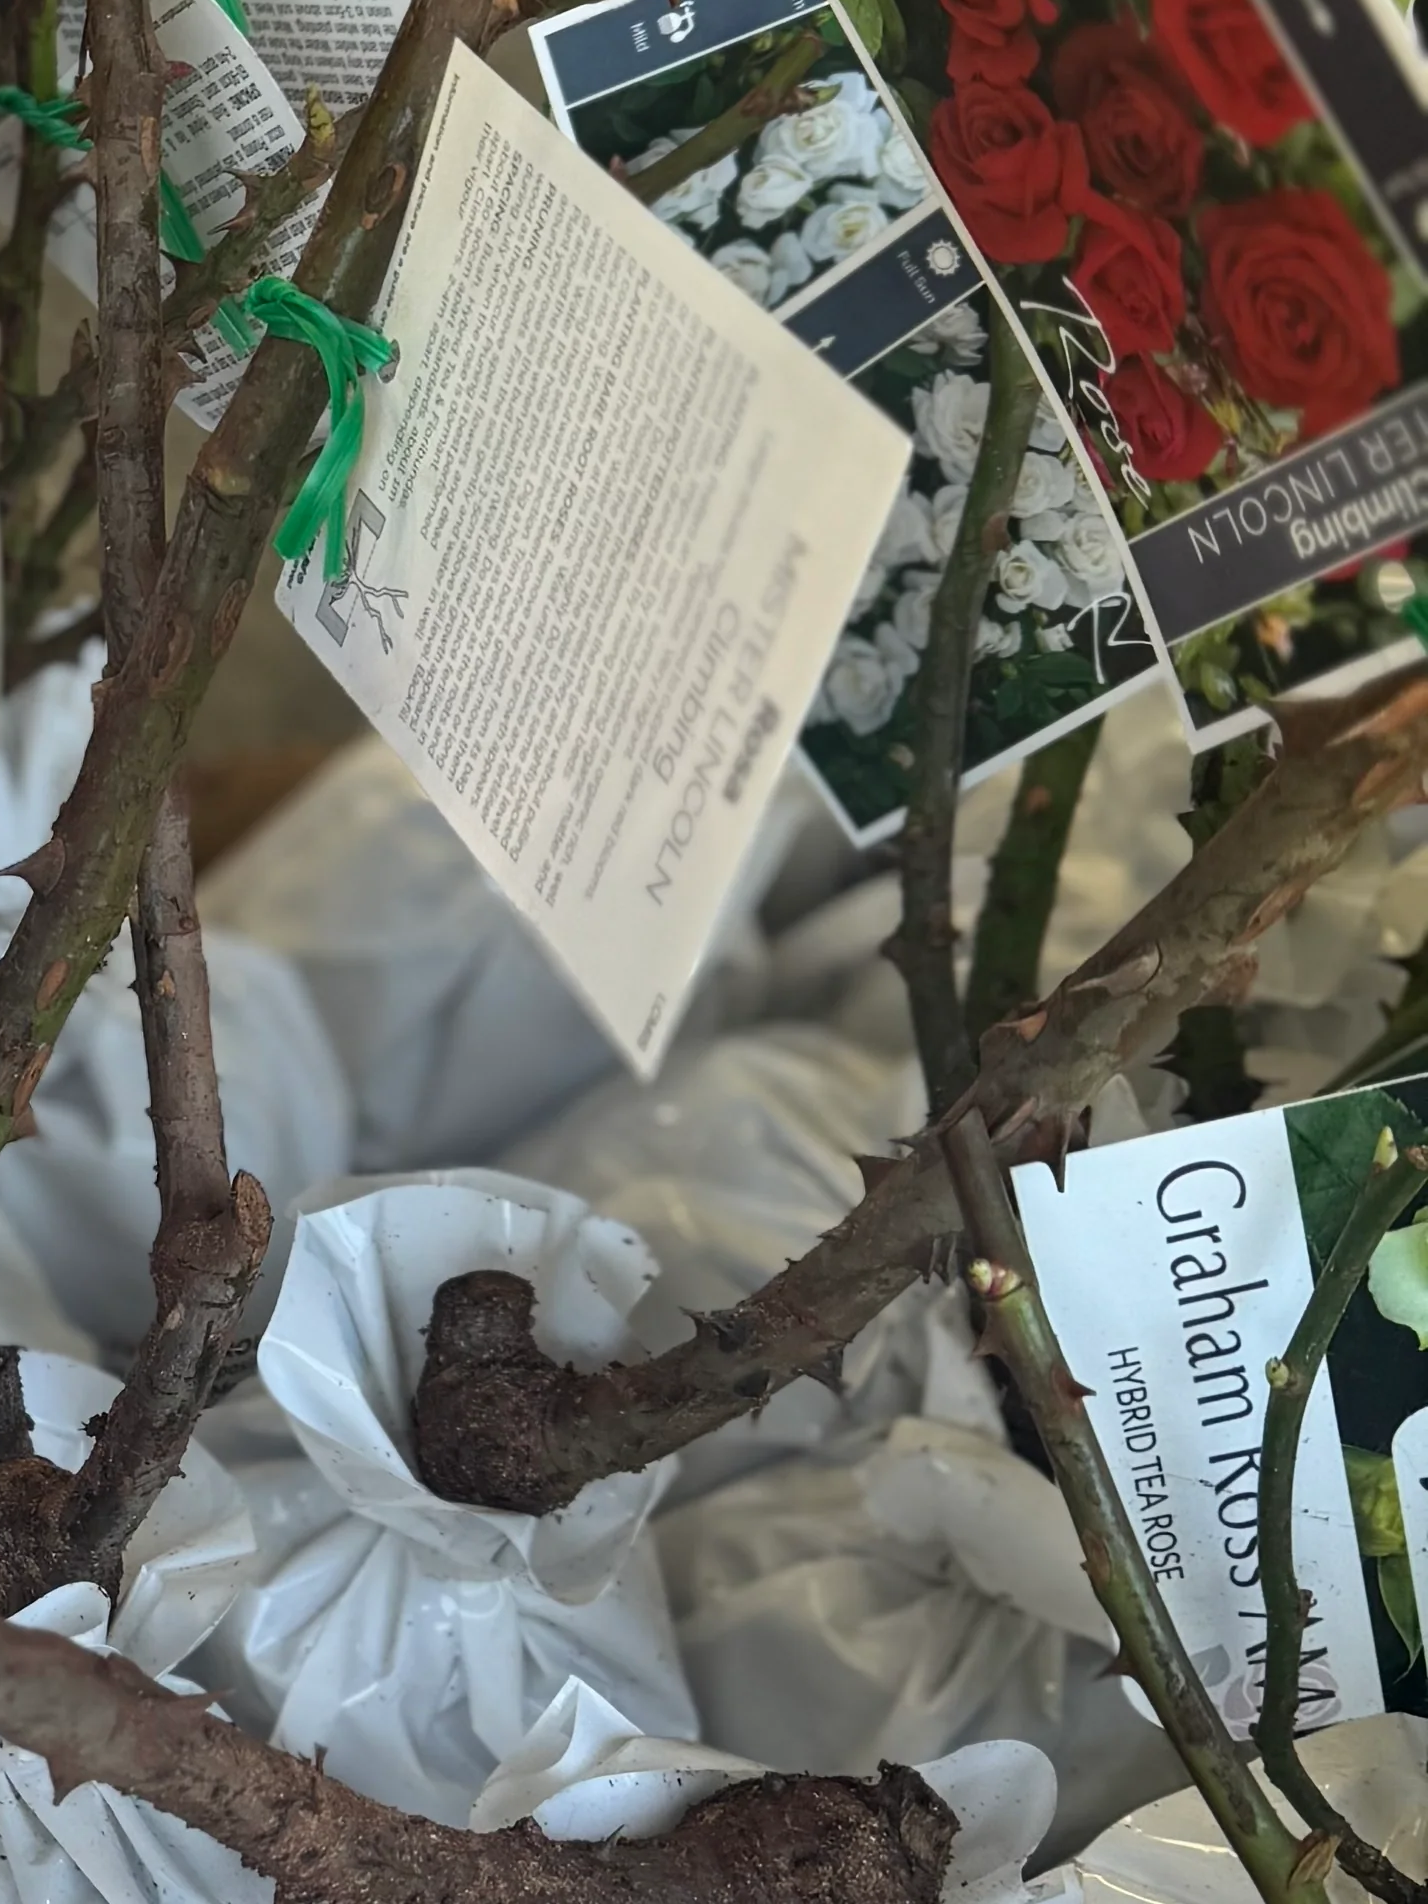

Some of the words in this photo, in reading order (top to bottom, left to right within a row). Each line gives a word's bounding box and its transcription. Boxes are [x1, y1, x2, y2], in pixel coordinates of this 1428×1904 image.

[485, 147, 525, 243] SPACING:
[517, 179, 559, 278] PRUNING:
[448, 292, 478, 359] Hybrid
[493, 273, 528, 354] Remove
[607, 265, 653, 372] PLANTING
[433, 391, 445, 410] &
[438, 357, 456, 394] Tea
[476, 349, 502, 406] spent
[590, 367, 618, 425] BARE
[1020, 275, 1152, 511] Rose
[455, 401, 485, 471] flowers
[570, 422, 599, 483] ROOT
[444, 466, 463, 506] and
[1187, 448, 1358, 564] LINCOLN
[428, 506, 450, 553] dead
[722, 524, 812, 716] MISTER
[649, 589, 745, 797] Climbing
[719, 689, 784, 820] Rosa
[642, 700, 740, 916] LINCOLN
[1155, 1158, 1270, 1428] Graham
[1107, 1347, 1157, 1453] HYBRID
[1131, 1457, 1170, 1512] TEA
[1142, 1514, 1184, 1583] ROSE
